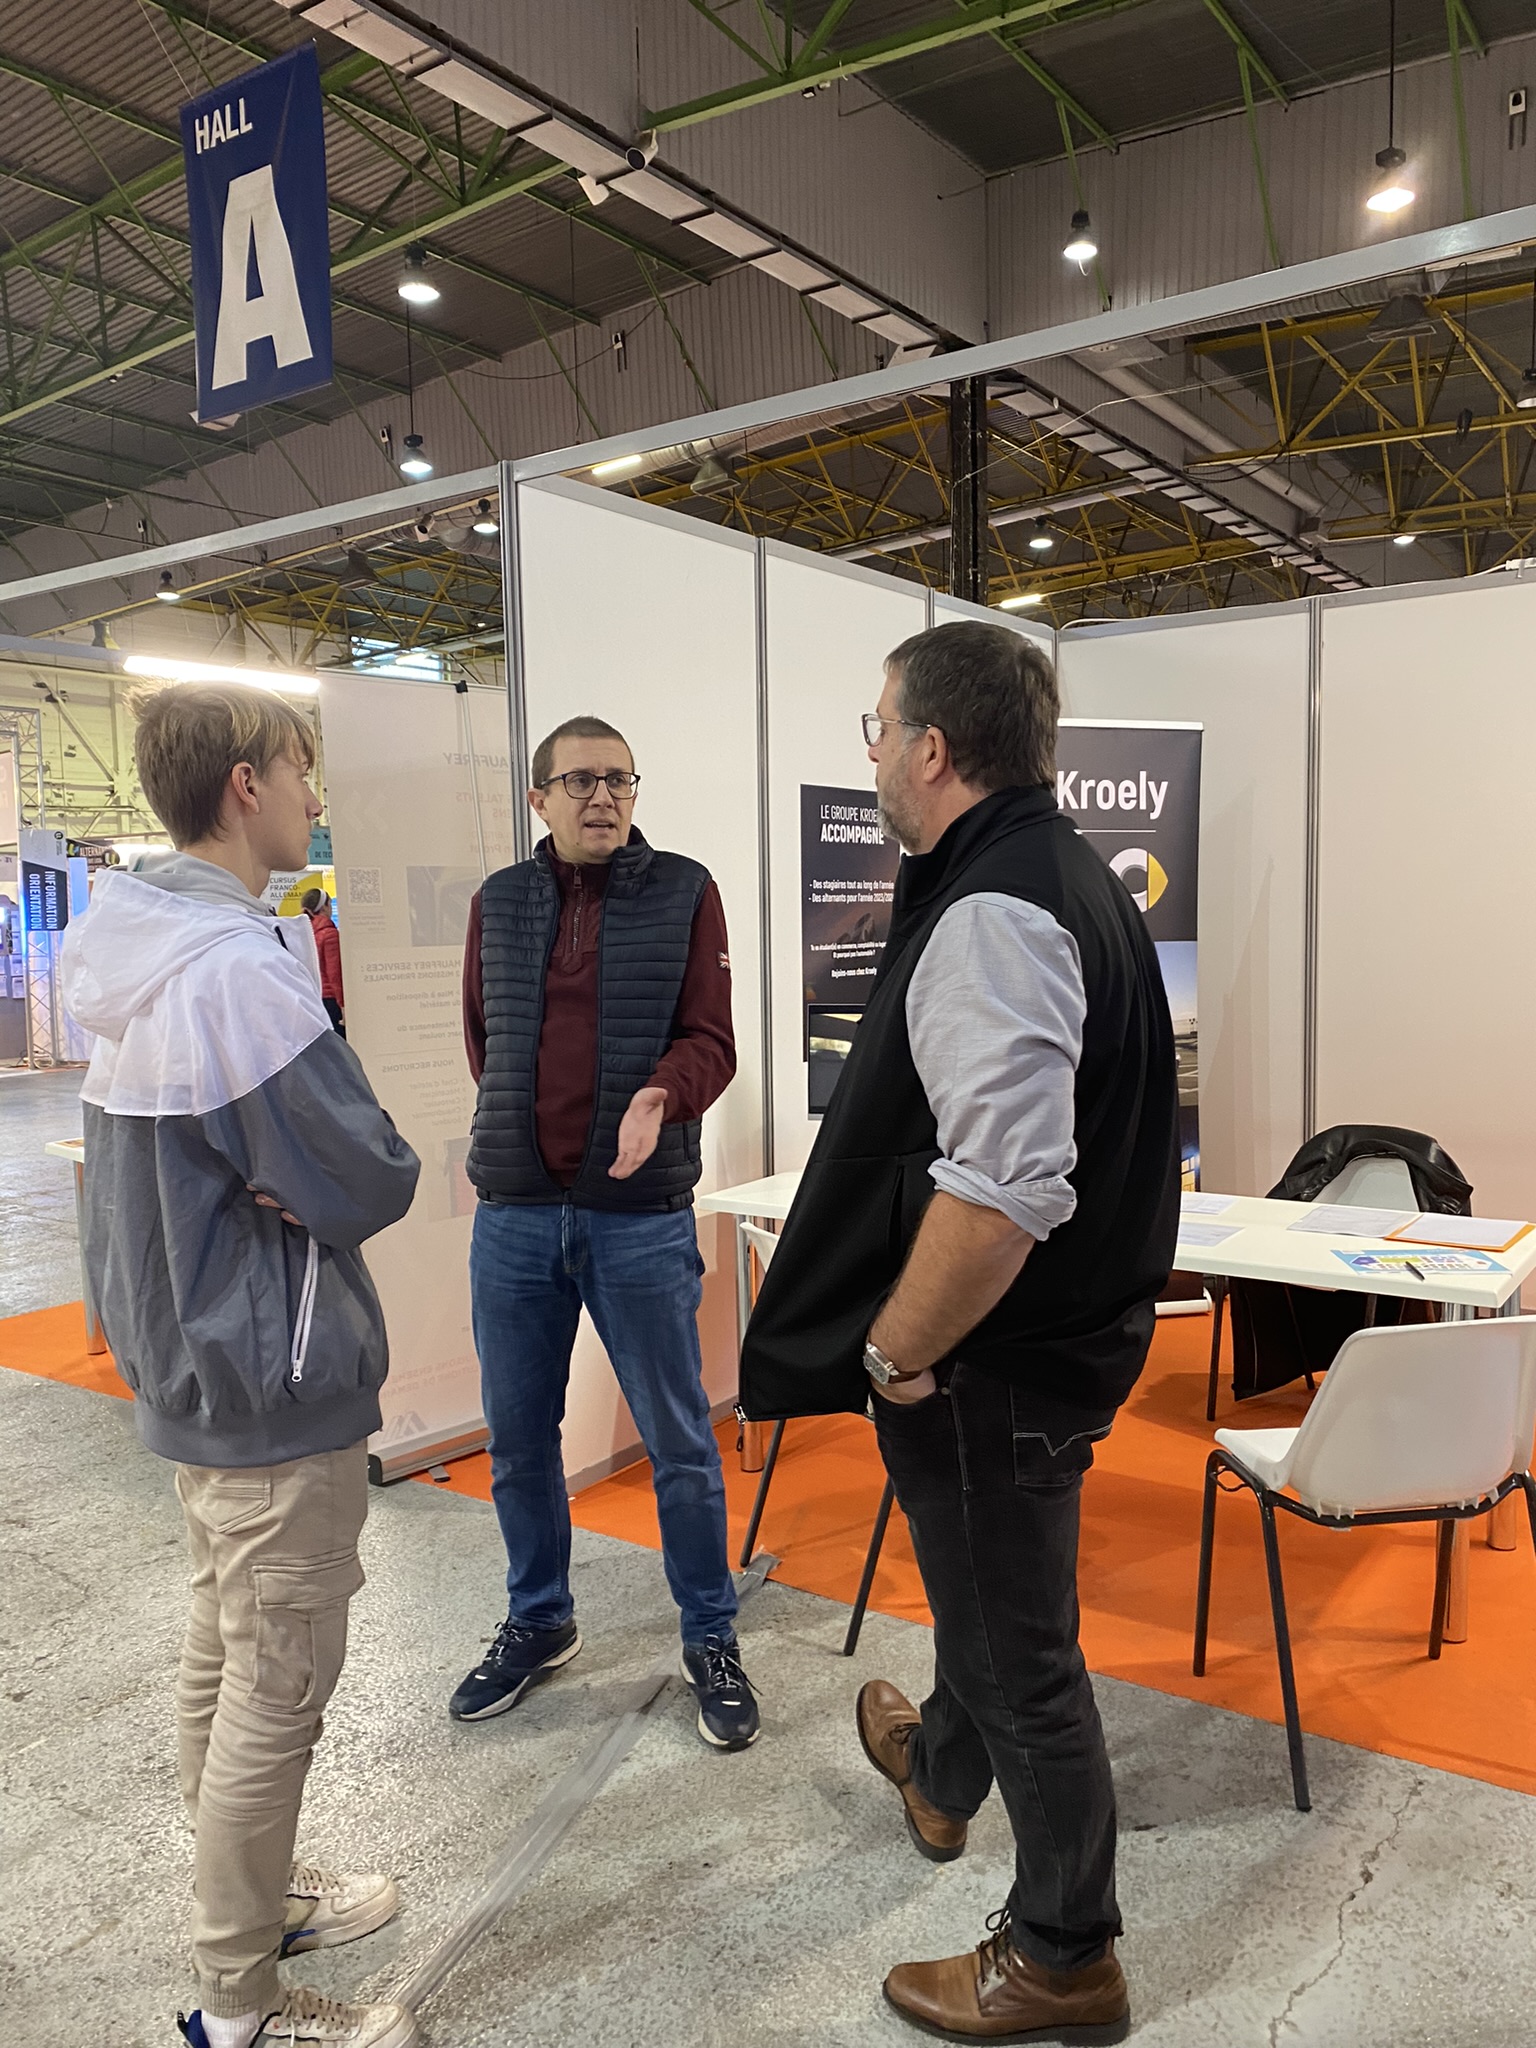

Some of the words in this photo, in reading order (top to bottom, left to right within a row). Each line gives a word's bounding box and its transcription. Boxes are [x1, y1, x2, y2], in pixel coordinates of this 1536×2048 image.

[195, 98, 253, 154] HALL
[212, 164, 313, 390] A
[820, 805, 829, 819] LE
[831, 806, 858, 821] GROUPE
[860, 808, 878, 822] KROE
[1057, 771, 1168, 819] Kroely
[820, 823, 884, 845] ACCOMPAGNE
[29, 873, 42, 930] ORIENTATION
[45, 871, 57, 930] INFORMATION
[812, 893, 822, 902] Des
[822, 893, 846, 902] alternants
[847, 894, 857, 904] pour
[813, 880, 822, 889] Des
[823, 880, 846, 891] stagiaires
[847, 881, 857, 889] tout
[863, 880, 873, 891] long
[873, 881, 879, 889] de
